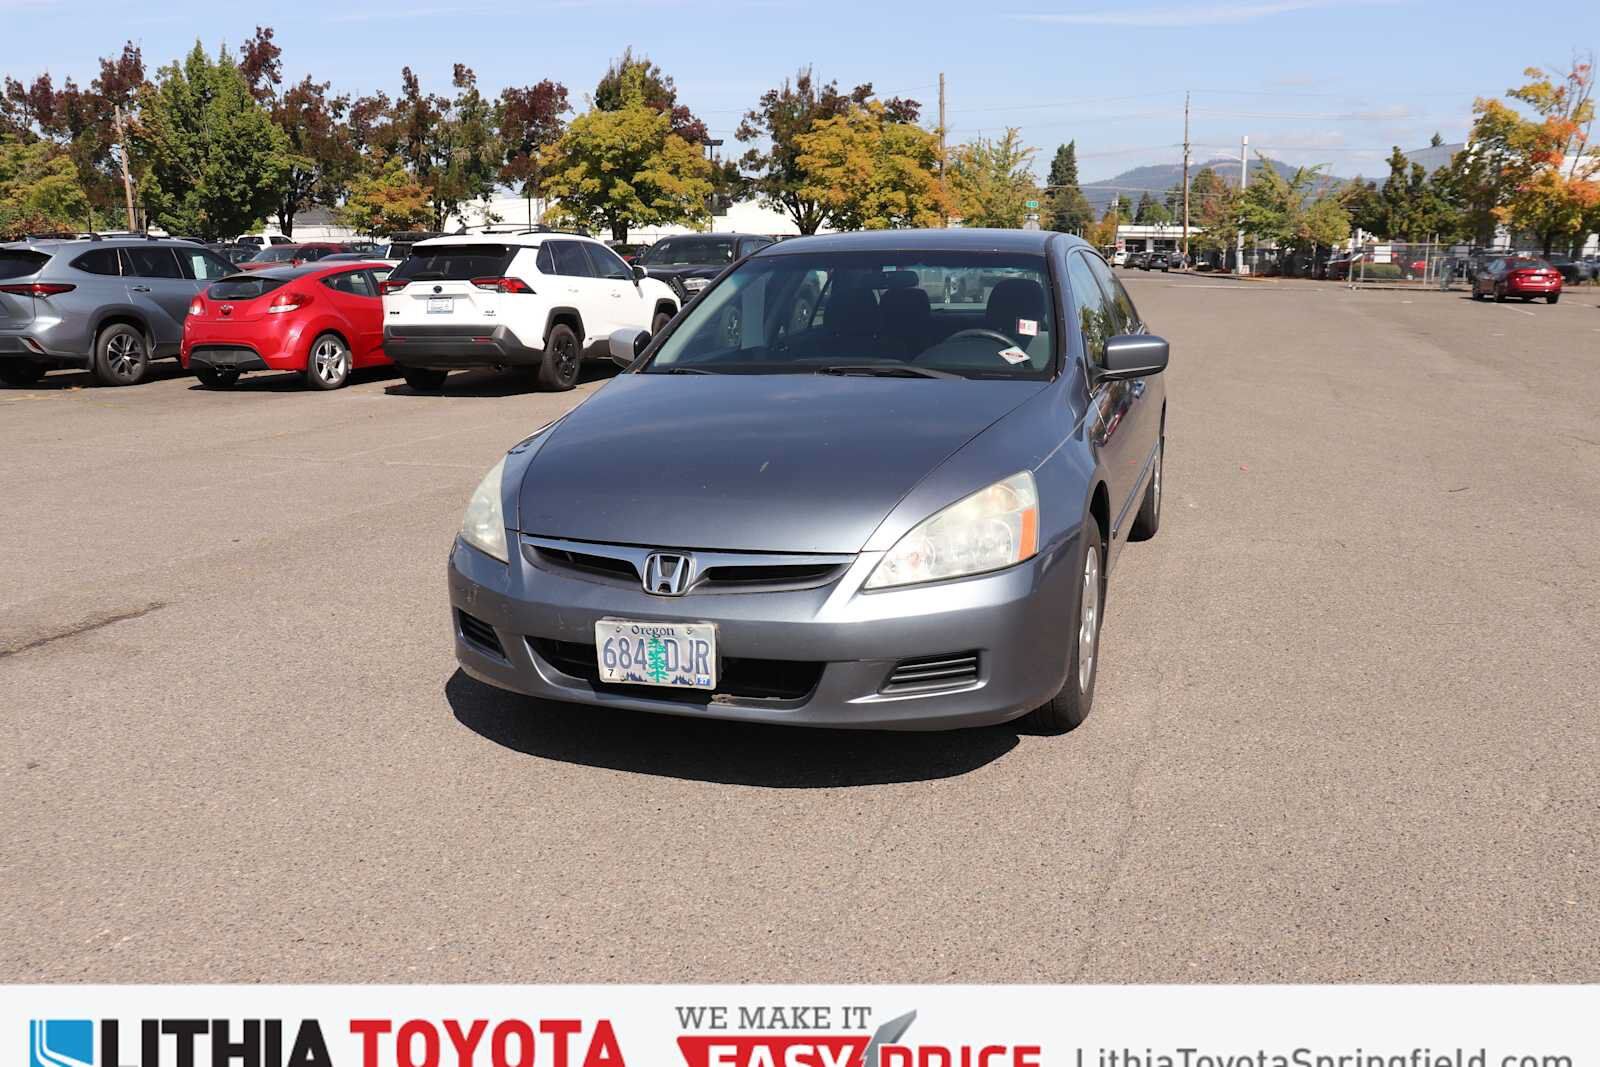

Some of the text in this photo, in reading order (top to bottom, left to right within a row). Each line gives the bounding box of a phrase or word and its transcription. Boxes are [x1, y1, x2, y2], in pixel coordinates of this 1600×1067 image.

[631, 624, 675, 638] Oregon
[603, 637, 710, 675] 684 DJR
